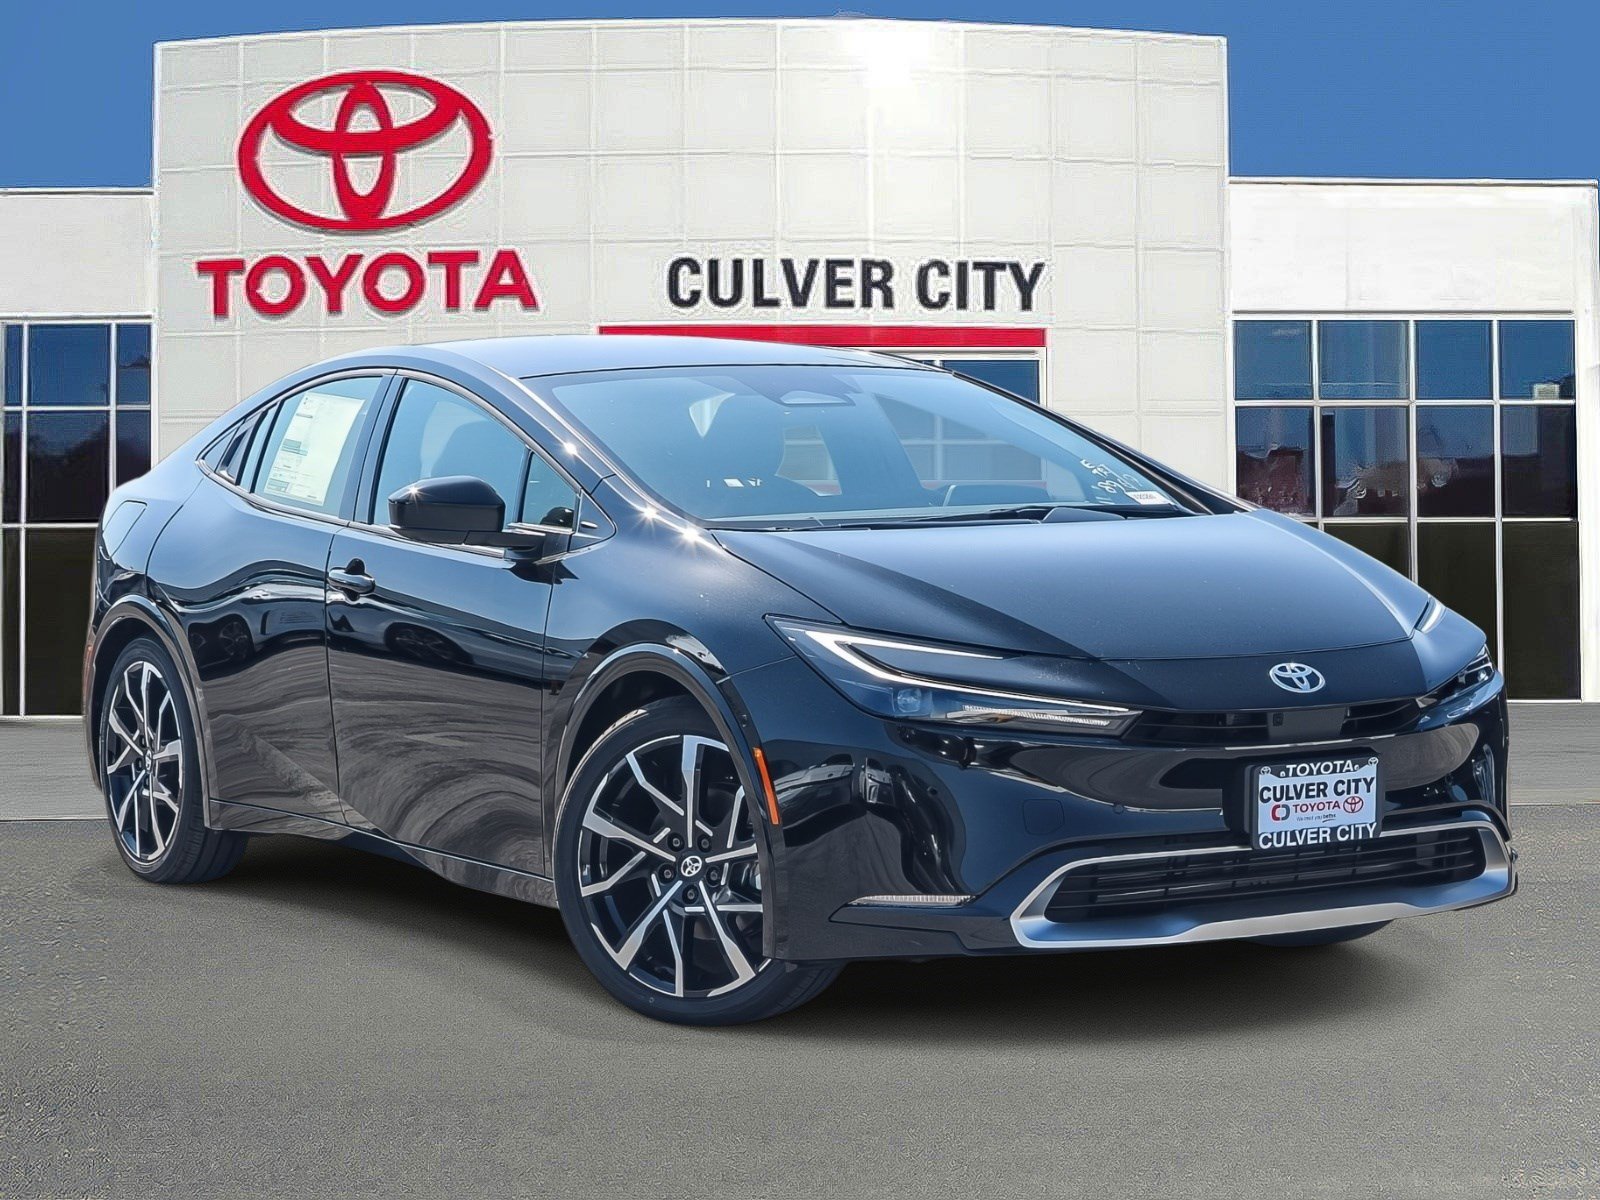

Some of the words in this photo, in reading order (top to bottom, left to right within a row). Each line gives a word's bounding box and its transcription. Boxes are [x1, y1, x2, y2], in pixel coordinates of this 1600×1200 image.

[196, 249, 540, 318] TOYOTA
[667, 257, 895, 309] CULVER
[915, 259, 1045, 311] CITY
[1286, 760, 1353, 777] TOYOTA
[1259, 781, 1328, 803] CULVER
[1333, 777, 1375, 797] CITY
[1292, 801, 1341, 813] TOYOTA
[1259, 827, 1330, 849] CULVER
[1337, 822, 1377, 842] CITY
